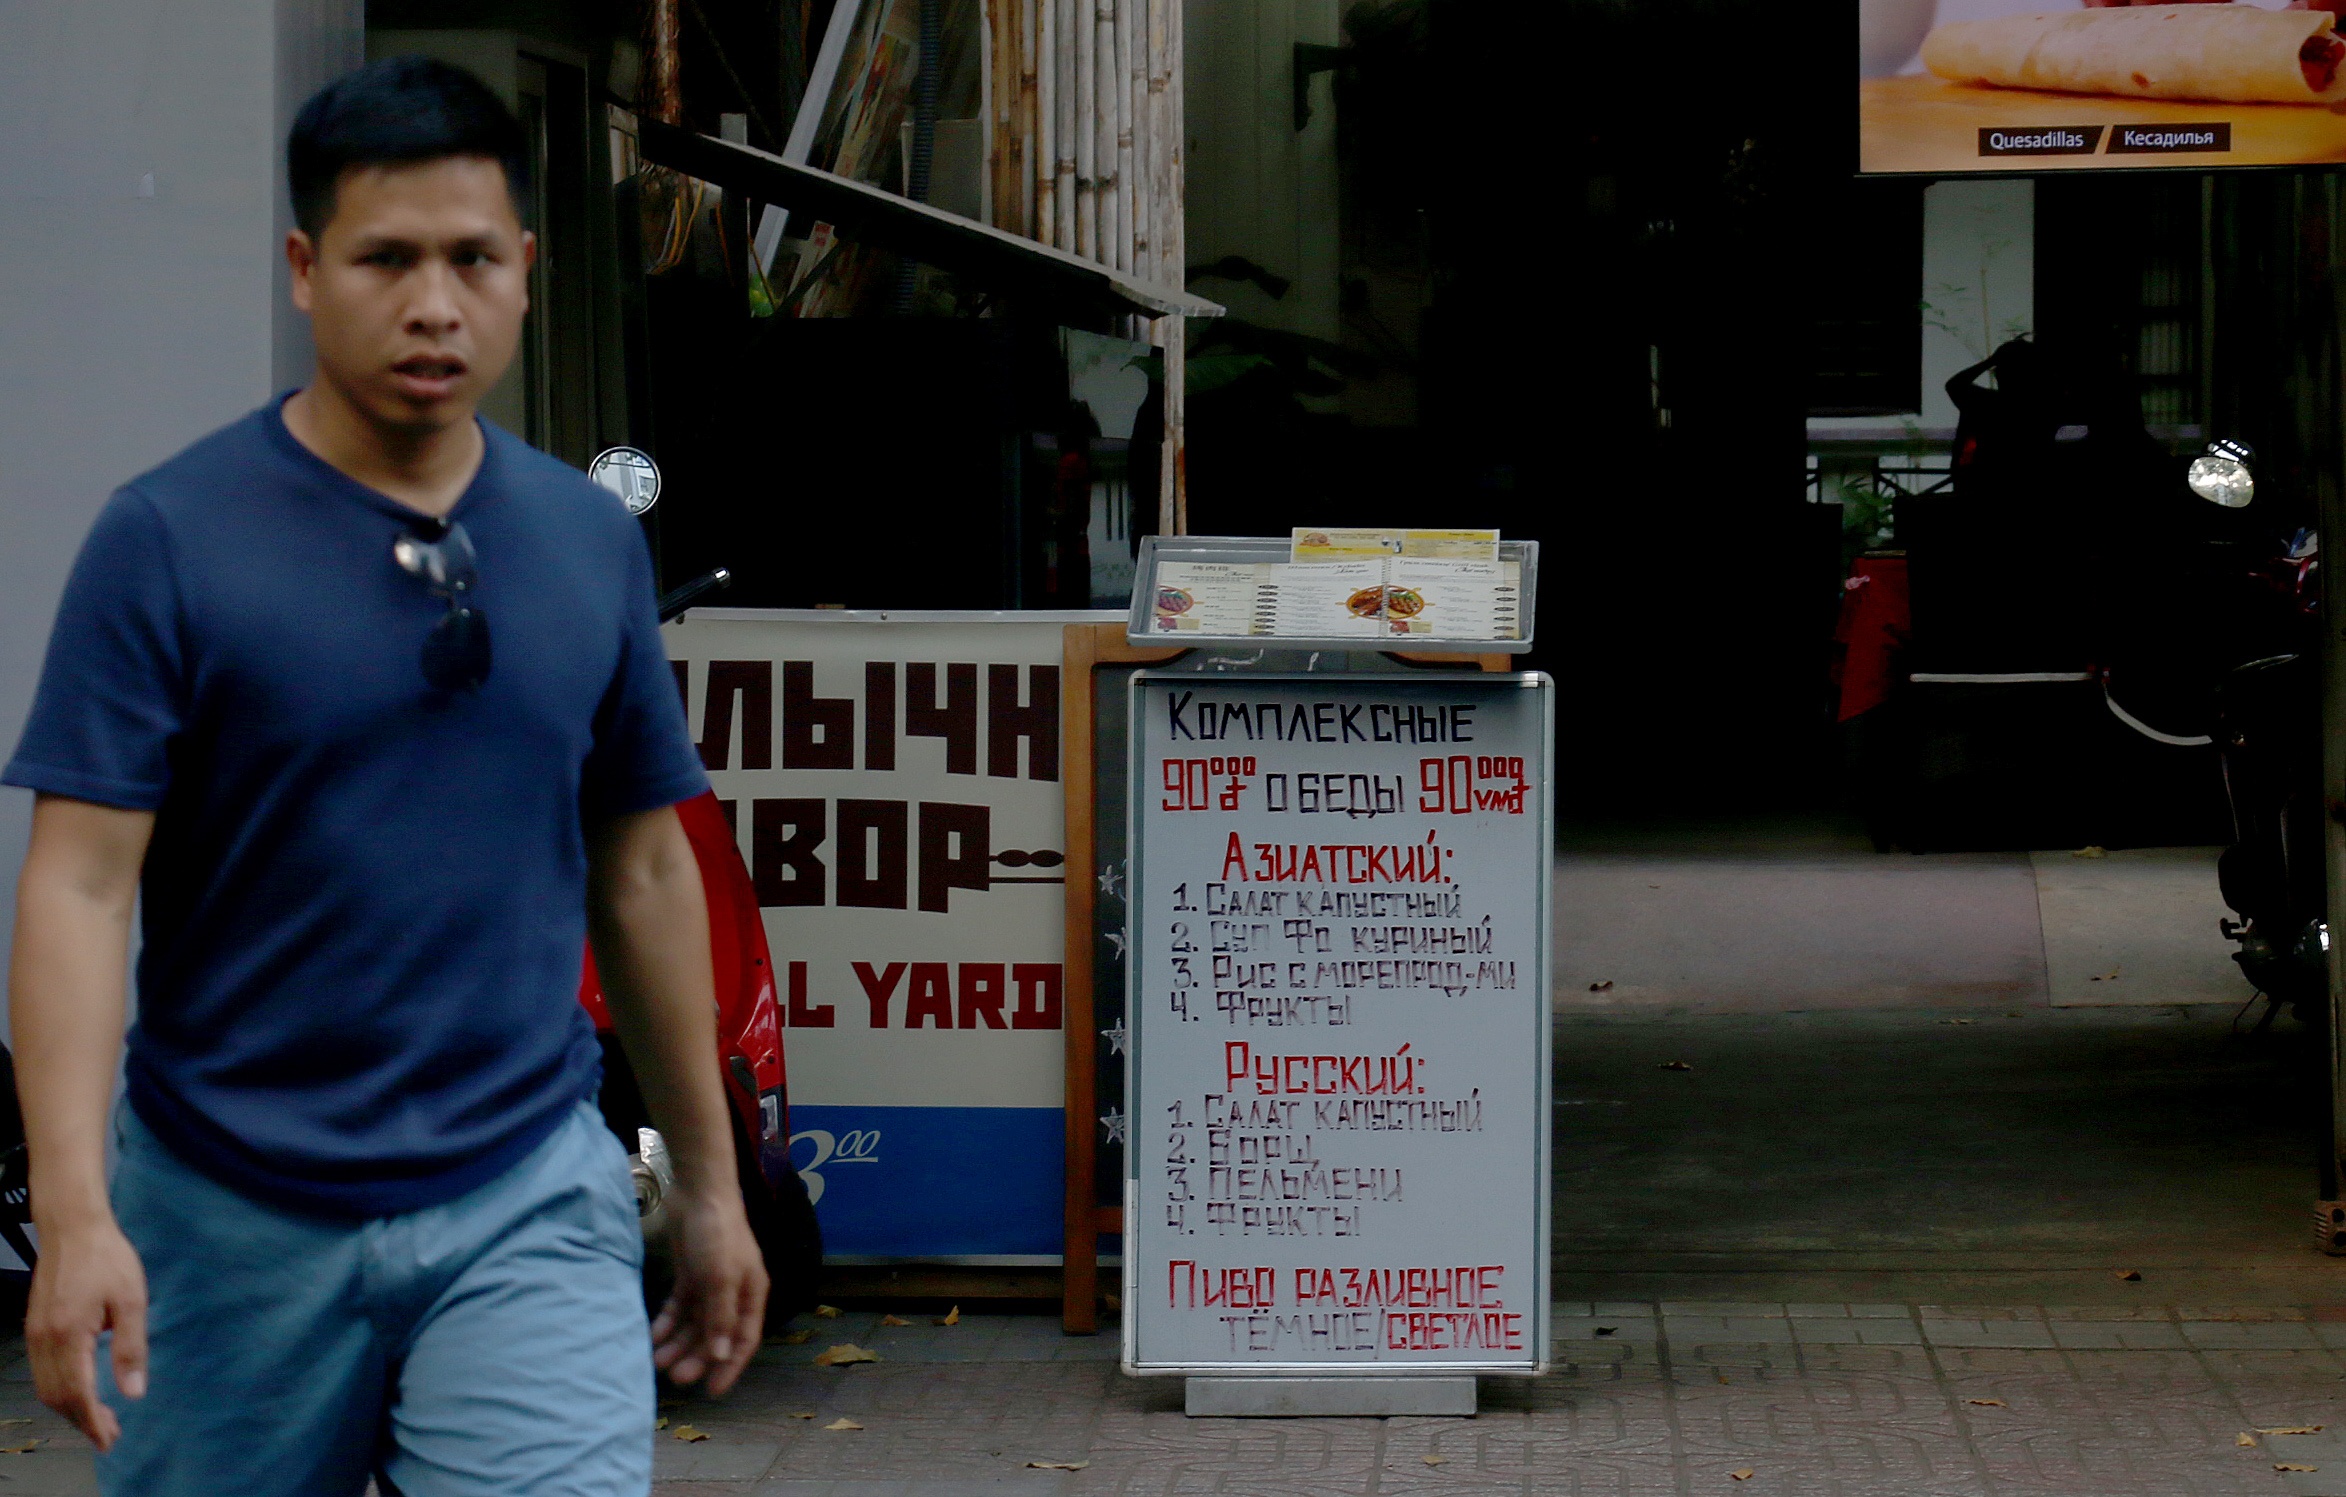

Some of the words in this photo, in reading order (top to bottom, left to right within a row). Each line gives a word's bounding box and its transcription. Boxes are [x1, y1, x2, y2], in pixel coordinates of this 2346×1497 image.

[1989, 132, 2084, 150] Quesadillas
[2124, 130, 2214, 148] Кесадилья
[667, 660, 1060, 782] ЛЫЧН
[717, 797, 990, 914] ВОР
[1173, 882, 1198, 911] 1.
[1171, 921, 1199, 952] 2.
[1172, 957, 1199, 988] 3.
[780, 961, 835, 1028] L
[851, 961, 1063, 1030] YARD
[1170, 991, 1199, 1022] 4.
[1167, 1099, 1194, 1129] 1.
[1167, 1133, 1196, 1165] 2.
[1167, 1165, 1195, 1202] 3.
[1166, 1205, 1195, 1236] 4.
